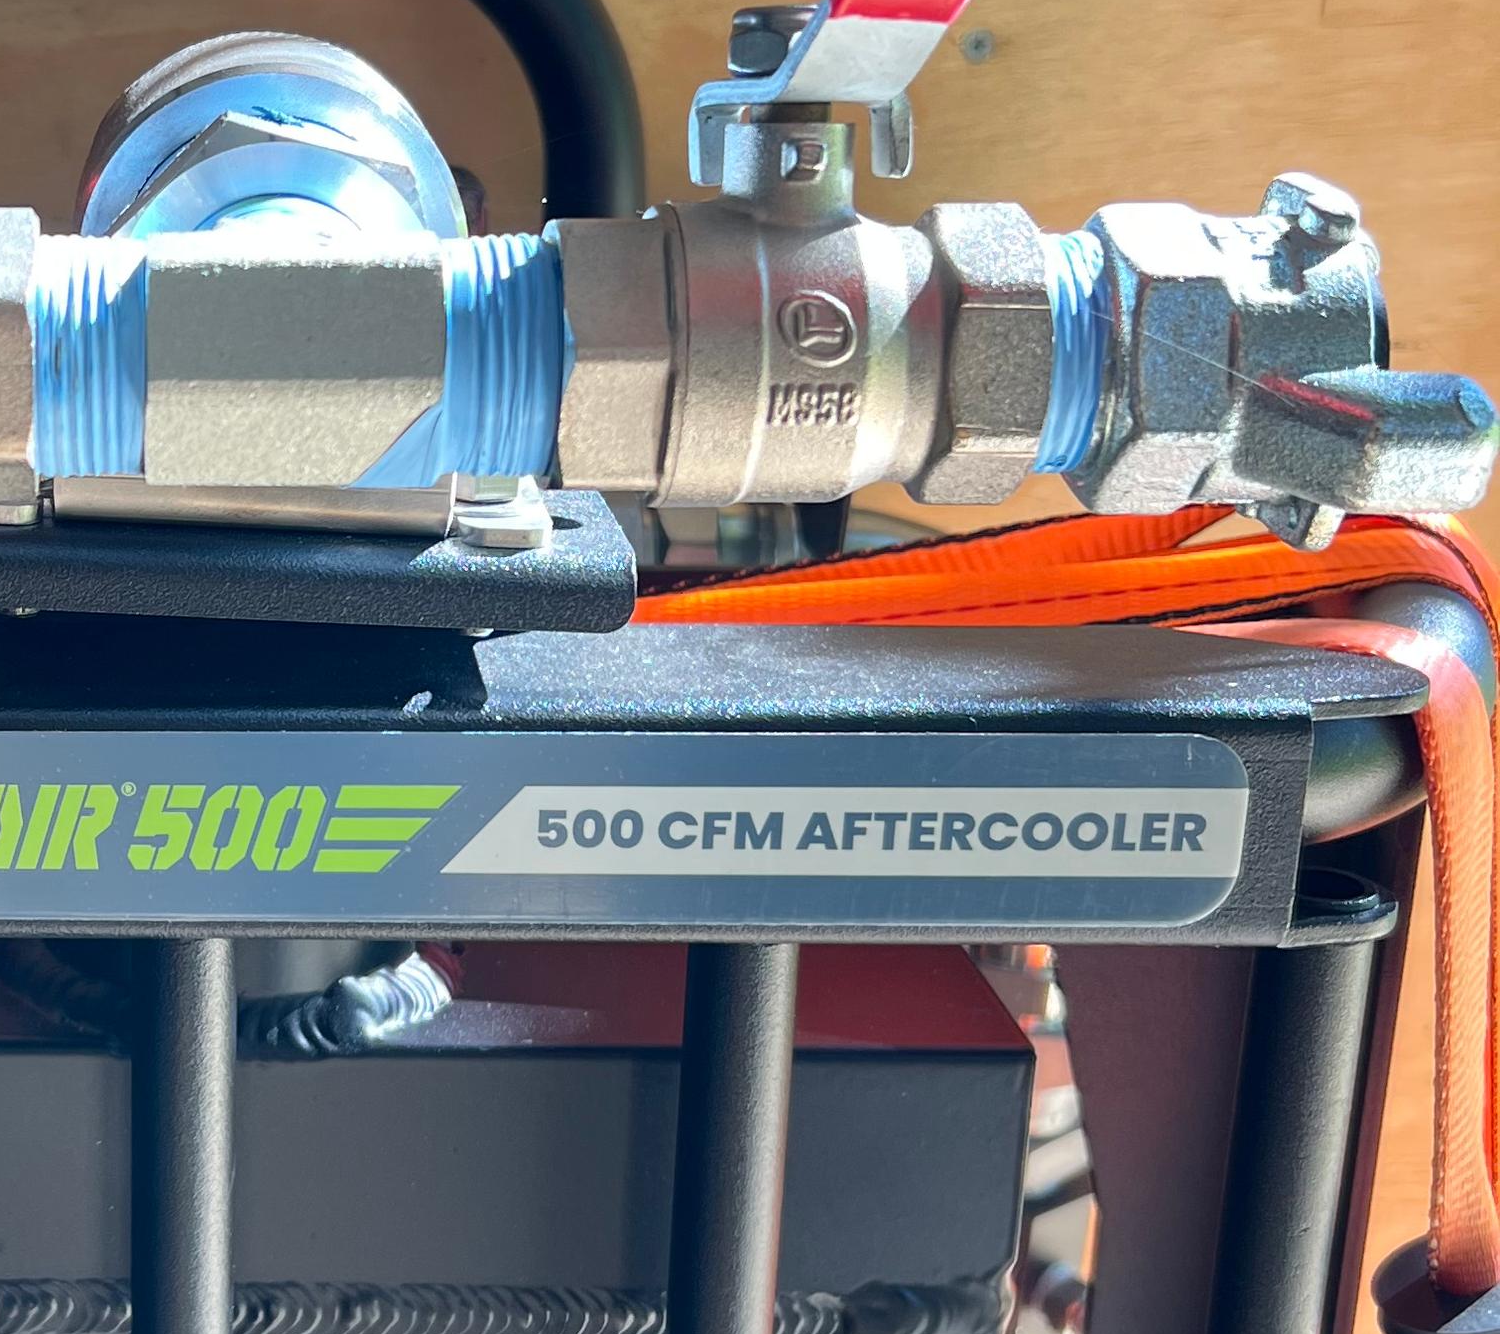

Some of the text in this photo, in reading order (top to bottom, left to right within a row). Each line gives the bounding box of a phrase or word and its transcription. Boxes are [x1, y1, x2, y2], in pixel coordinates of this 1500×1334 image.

[126, 784, 329, 873] 500
[536, 808, 1207, 853] 500 CFM AFTERCOOLER
